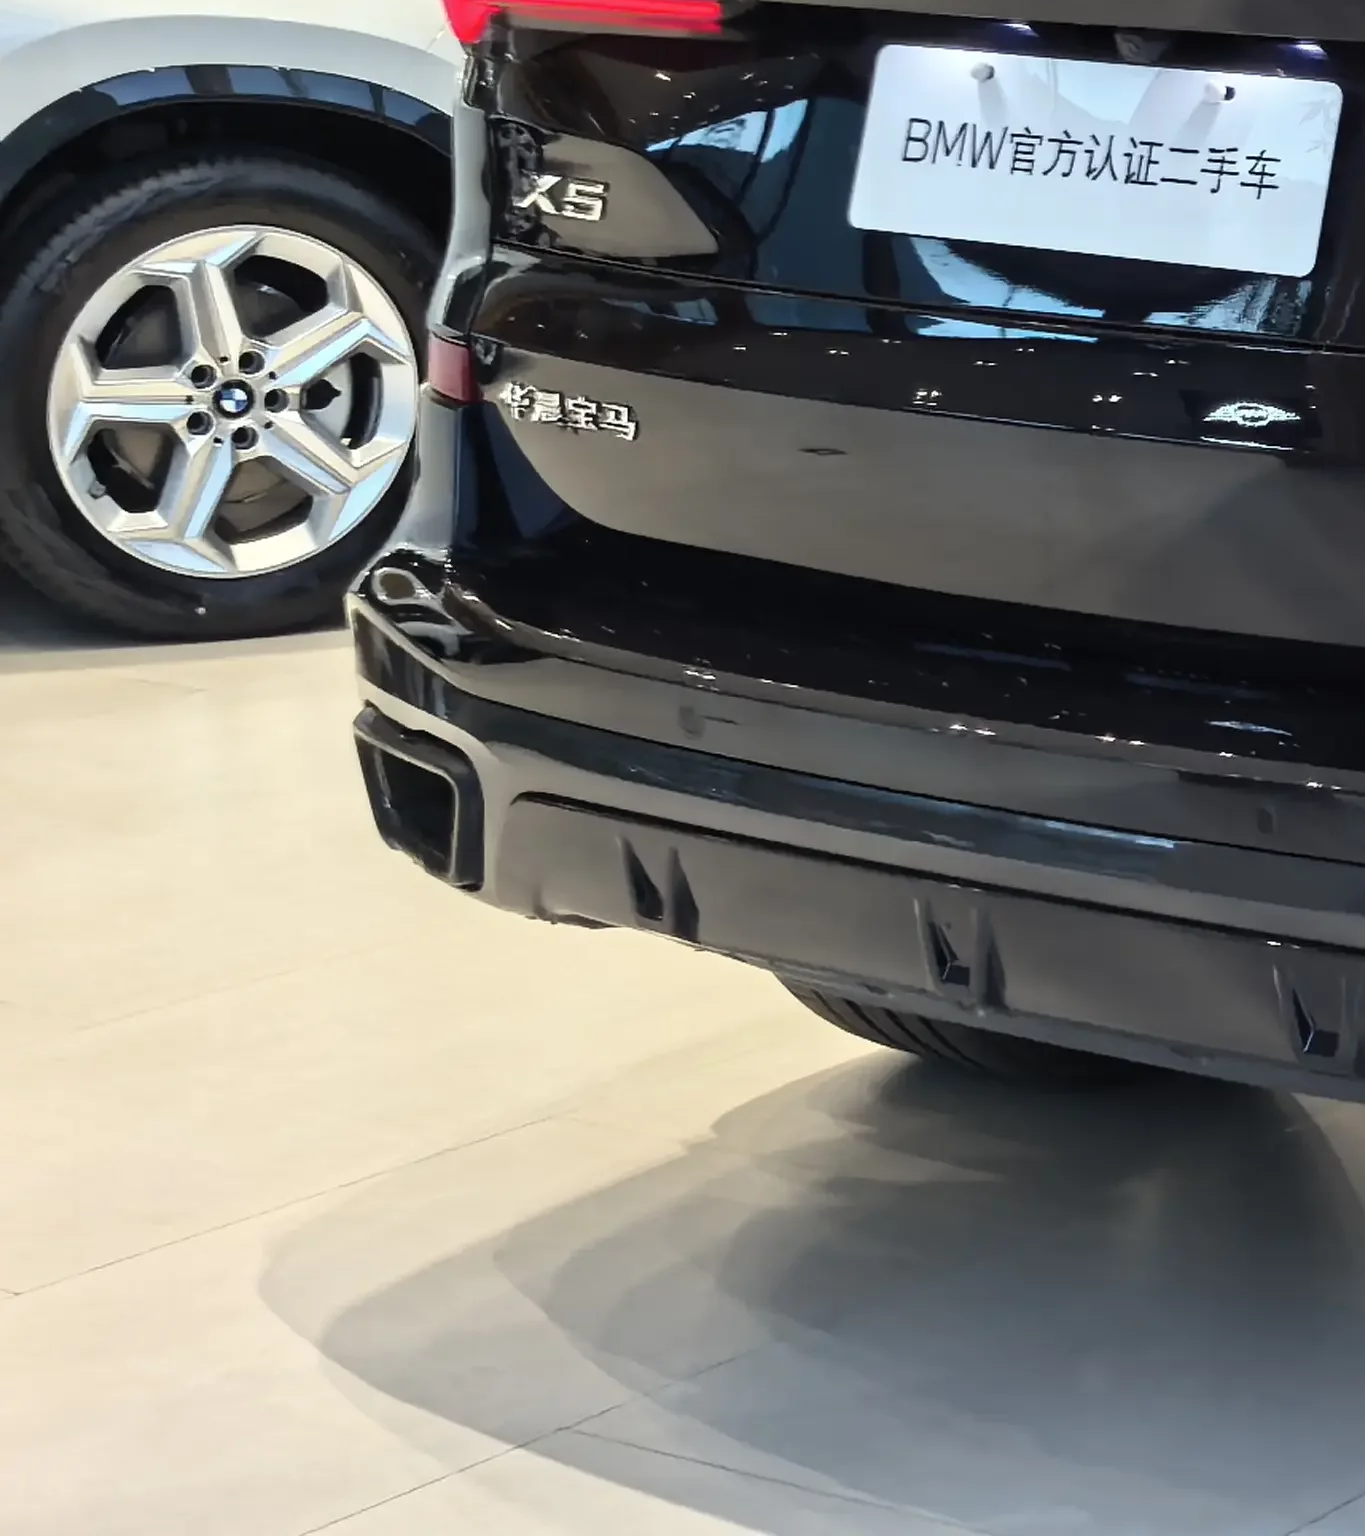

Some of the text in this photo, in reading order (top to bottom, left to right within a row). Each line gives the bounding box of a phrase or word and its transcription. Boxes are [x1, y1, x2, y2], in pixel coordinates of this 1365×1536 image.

[901, 117, 1282, 200] BMW官方认证二手车
[511, 170, 606, 221] X5
[499, 382, 638, 441] 华晨宝马
